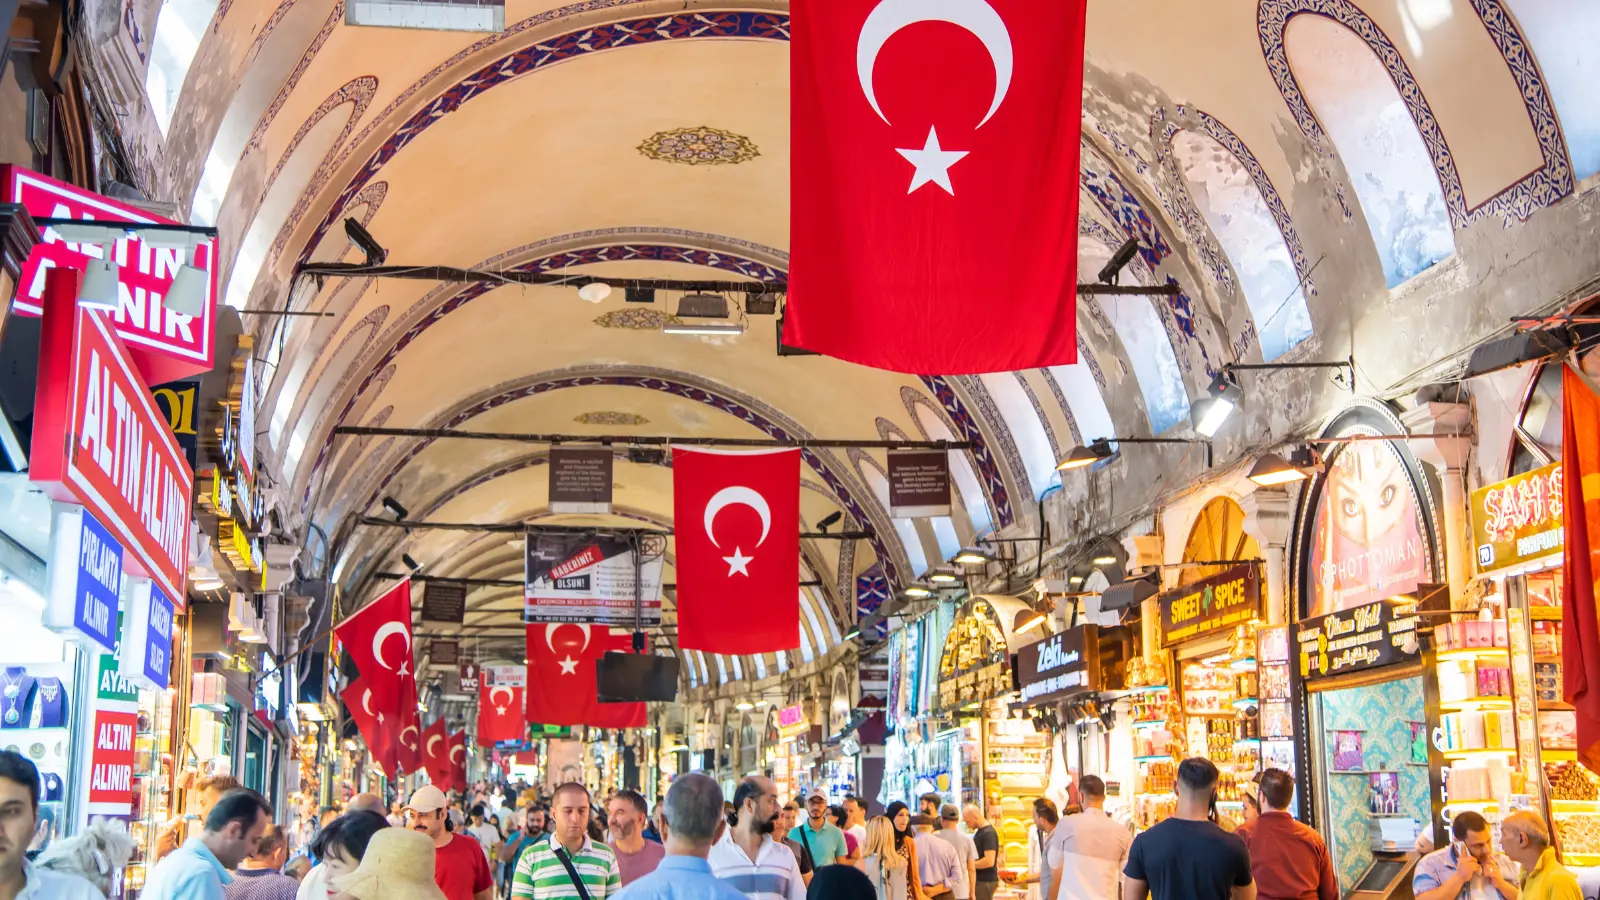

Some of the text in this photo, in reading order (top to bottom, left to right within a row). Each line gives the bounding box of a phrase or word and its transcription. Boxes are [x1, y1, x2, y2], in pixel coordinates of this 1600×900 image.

[81, 348, 186, 575] ALTIN ALINIR
[81, 525, 119, 596] PIRLANTA
[552, 551, 594, 579] HABERİNİZ
[557, 578, 585, 589] OLSUN!
[83, 591, 109, 638] ALINIR
[1171, 578, 1245, 624] SWEET SPICE
[1037, 635, 1062, 673] Zeki
[461, 678, 478, 687] WC
[98, 723, 132, 751] ALTIN
[92, 764, 131, 792] ALINIR
